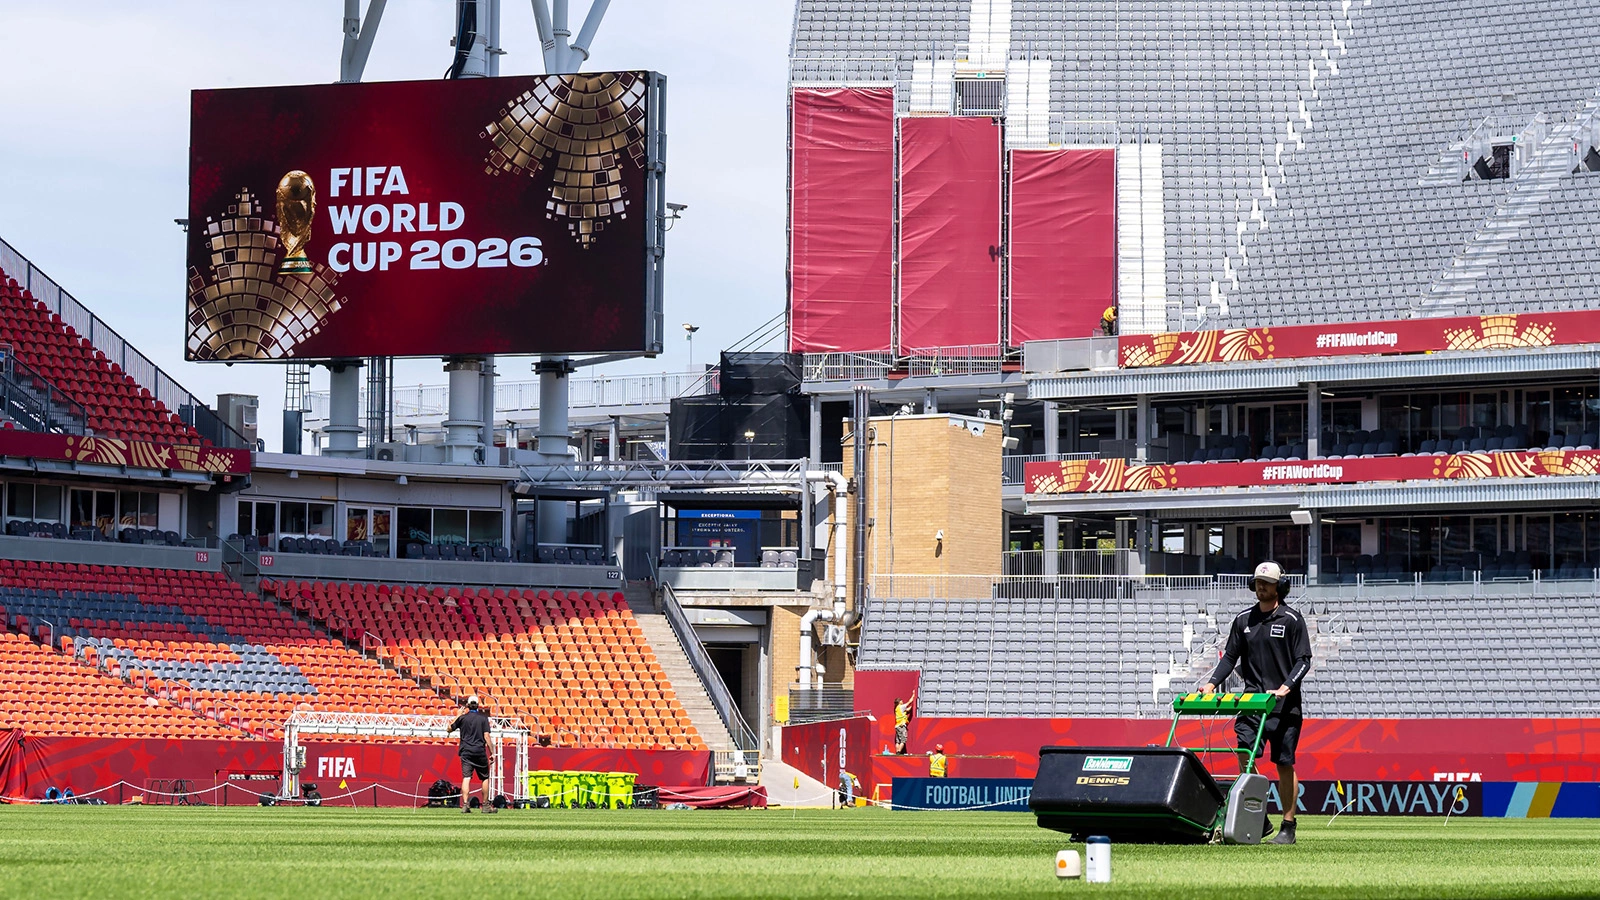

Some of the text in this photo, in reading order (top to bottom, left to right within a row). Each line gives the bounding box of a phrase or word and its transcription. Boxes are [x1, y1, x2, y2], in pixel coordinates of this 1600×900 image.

[330, 166, 409, 197] FIFA
[328, 202, 465, 234] WORLD
[328, 236, 543, 273] CUP 2026
[1316, 331, 1398, 348] #FIFAWorldCup
[1262, 464, 1343, 480] #FIFAWorldCup
[197, 552, 207, 562] 126
[262, 556, 273, 565] 127
[608, 571, 619, 579] 127
[318, 757, 357, 778] FIFA
[926, 785, 991, 805] FOOTBALL
[1321, 783, 1470, 814] AIRWAYS
